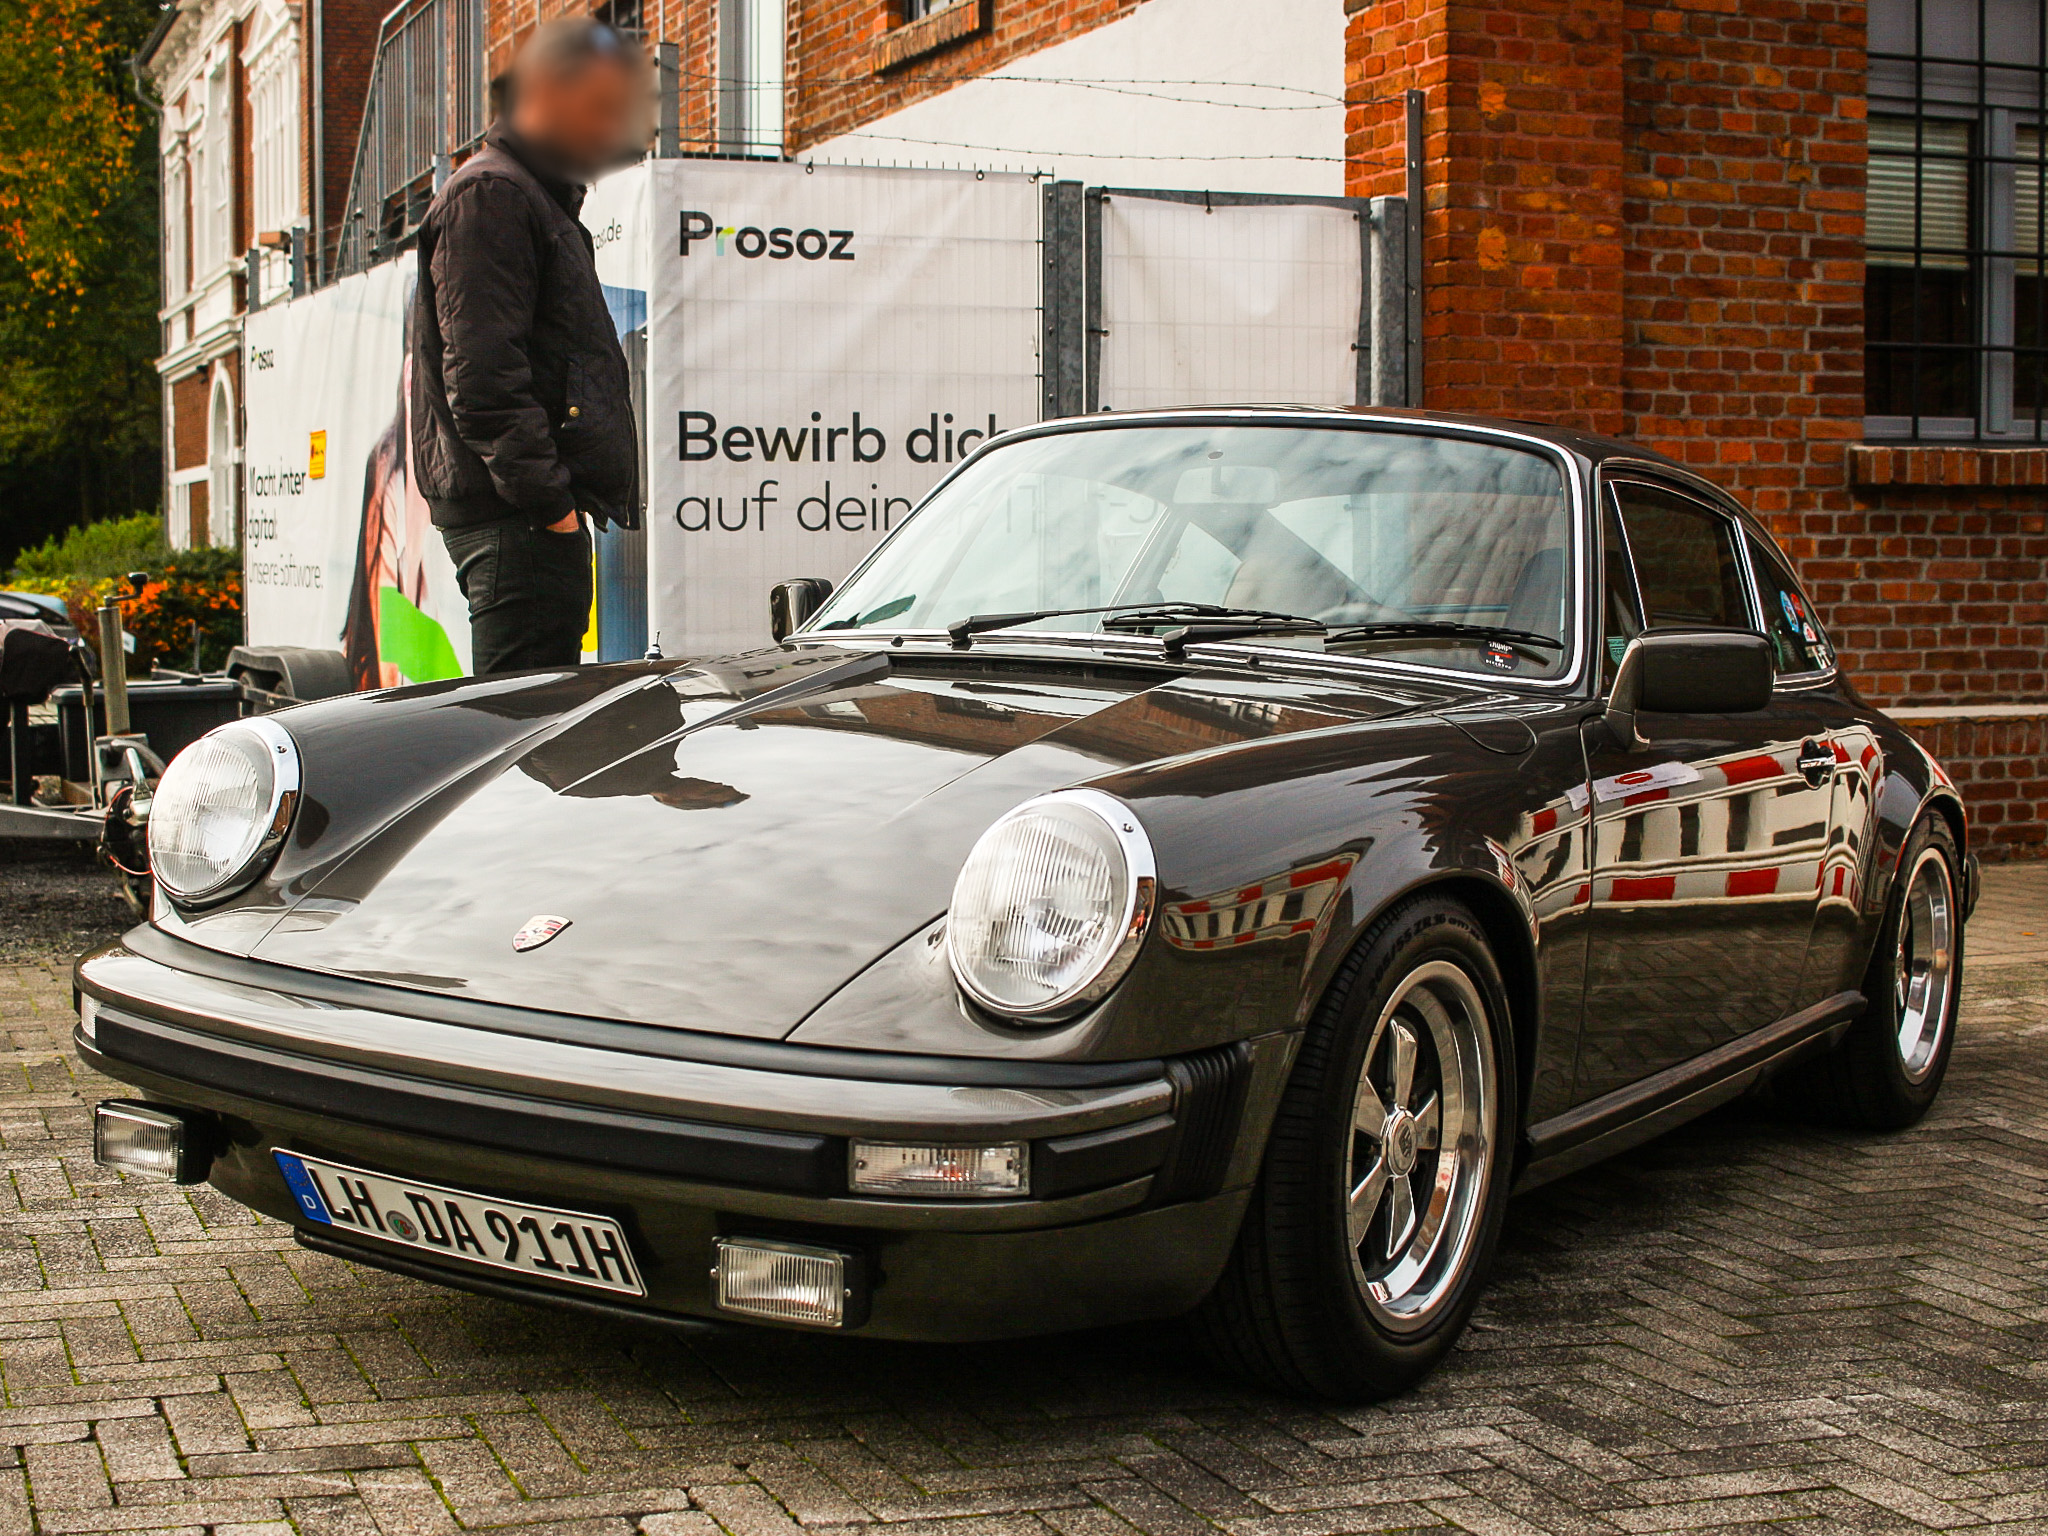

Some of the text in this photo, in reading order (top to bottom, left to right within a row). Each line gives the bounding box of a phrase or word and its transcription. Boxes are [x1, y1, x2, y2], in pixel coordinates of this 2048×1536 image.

[678, 211, 856, 261] Prosoz
[678, 411, 887, 464] Bewirb
[675, 480, 779, 532] auf
[248, 552, 279, 586] Unsere
[301, 1194, 317, 1209] D
[307, 1166, 635, 1286] LH DA 911H
